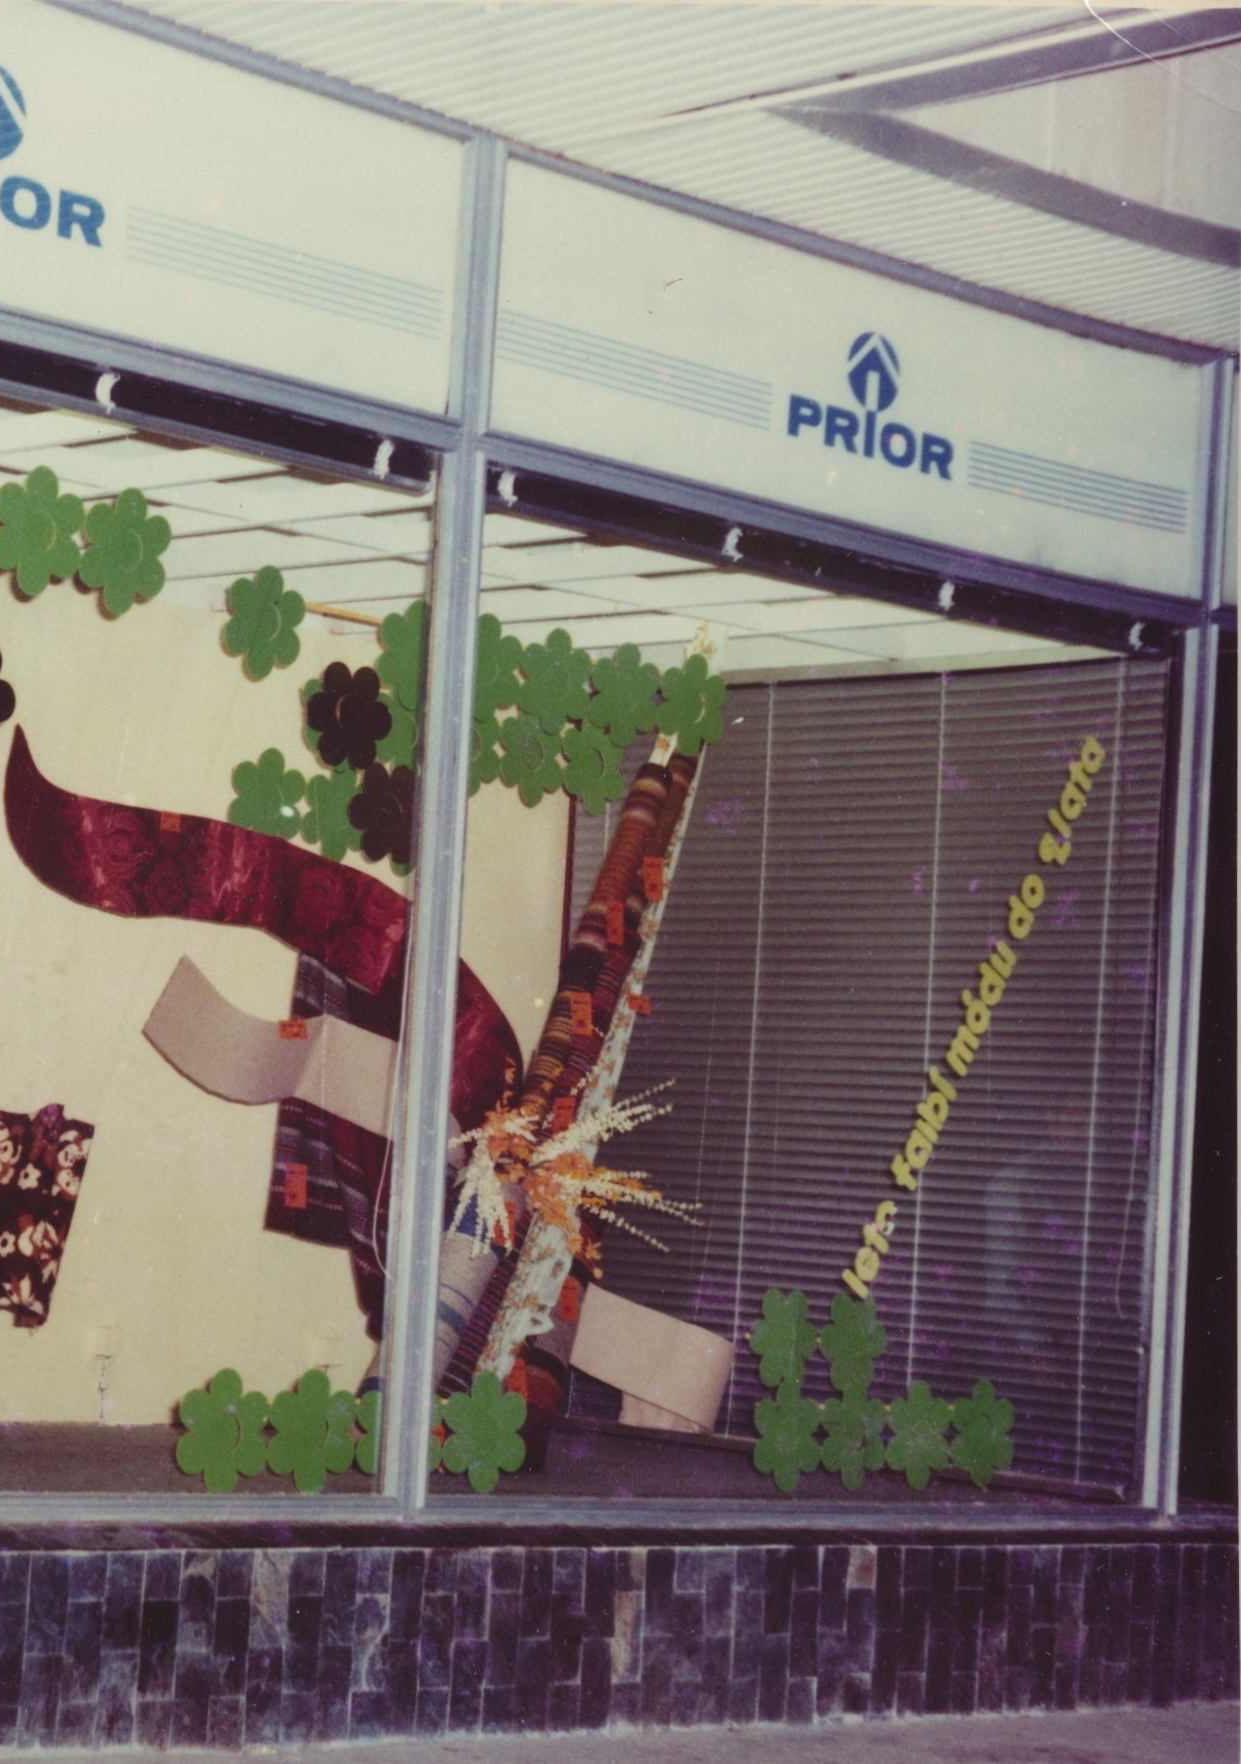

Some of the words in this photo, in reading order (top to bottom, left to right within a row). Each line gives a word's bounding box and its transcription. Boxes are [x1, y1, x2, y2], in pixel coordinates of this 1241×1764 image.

[787, 393, 954, 481] PRIOR
[946, 940, 1017, 1077] módu
[1008, 874, 1045, 939] do
[1038, 735, 1105, 865] zlata
